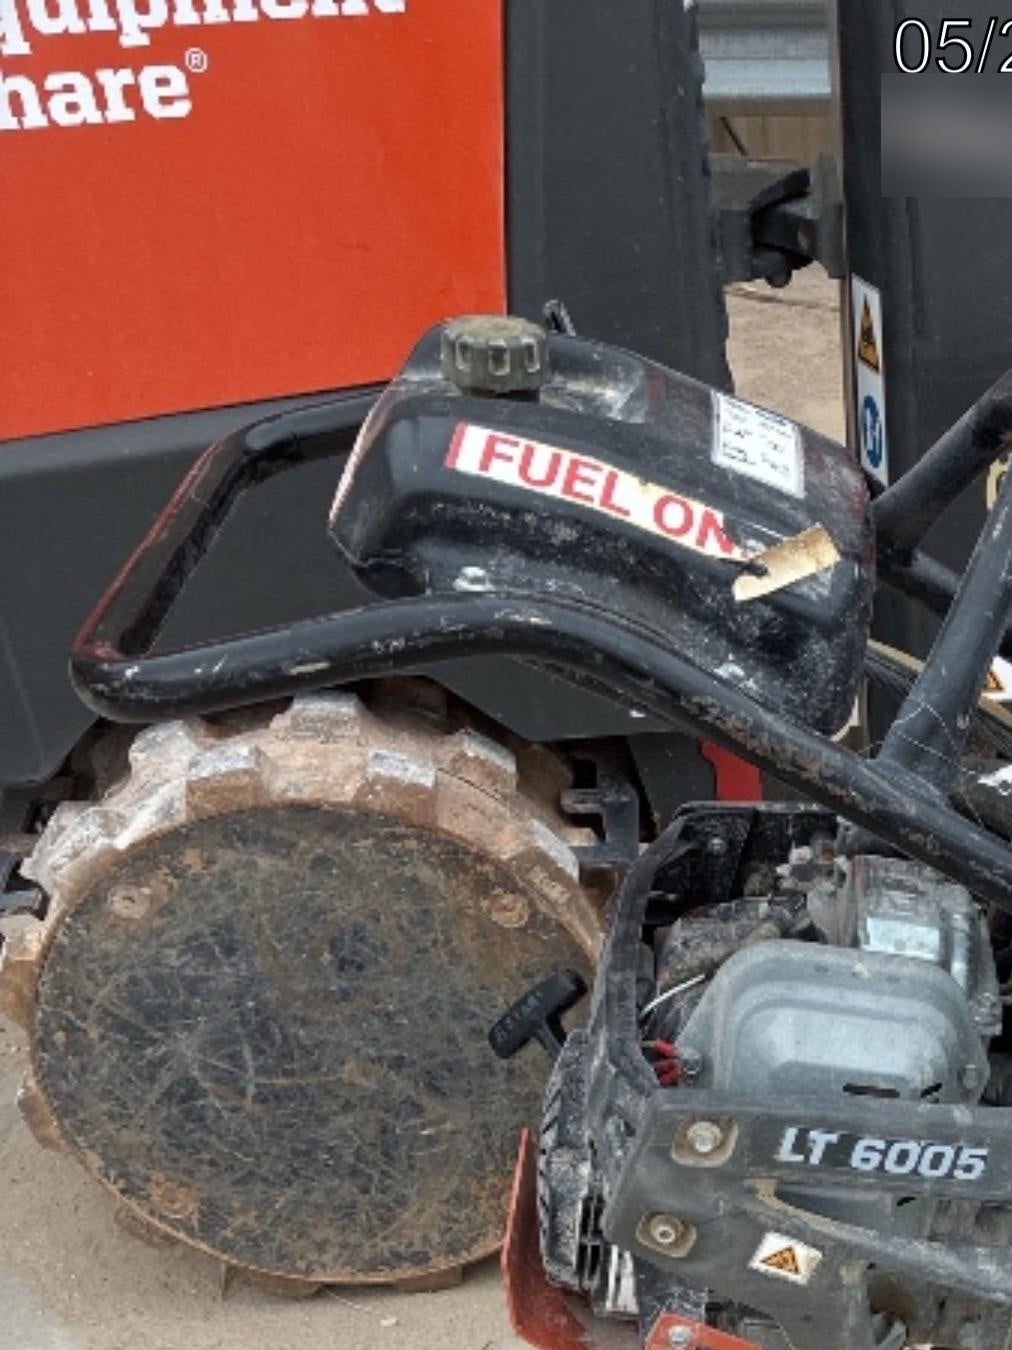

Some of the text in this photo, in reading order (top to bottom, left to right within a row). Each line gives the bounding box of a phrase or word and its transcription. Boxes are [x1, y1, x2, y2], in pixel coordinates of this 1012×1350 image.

[478, 434, 736, 556] FUEL ON
[773, 1126, 989, 1181] LT 6005
